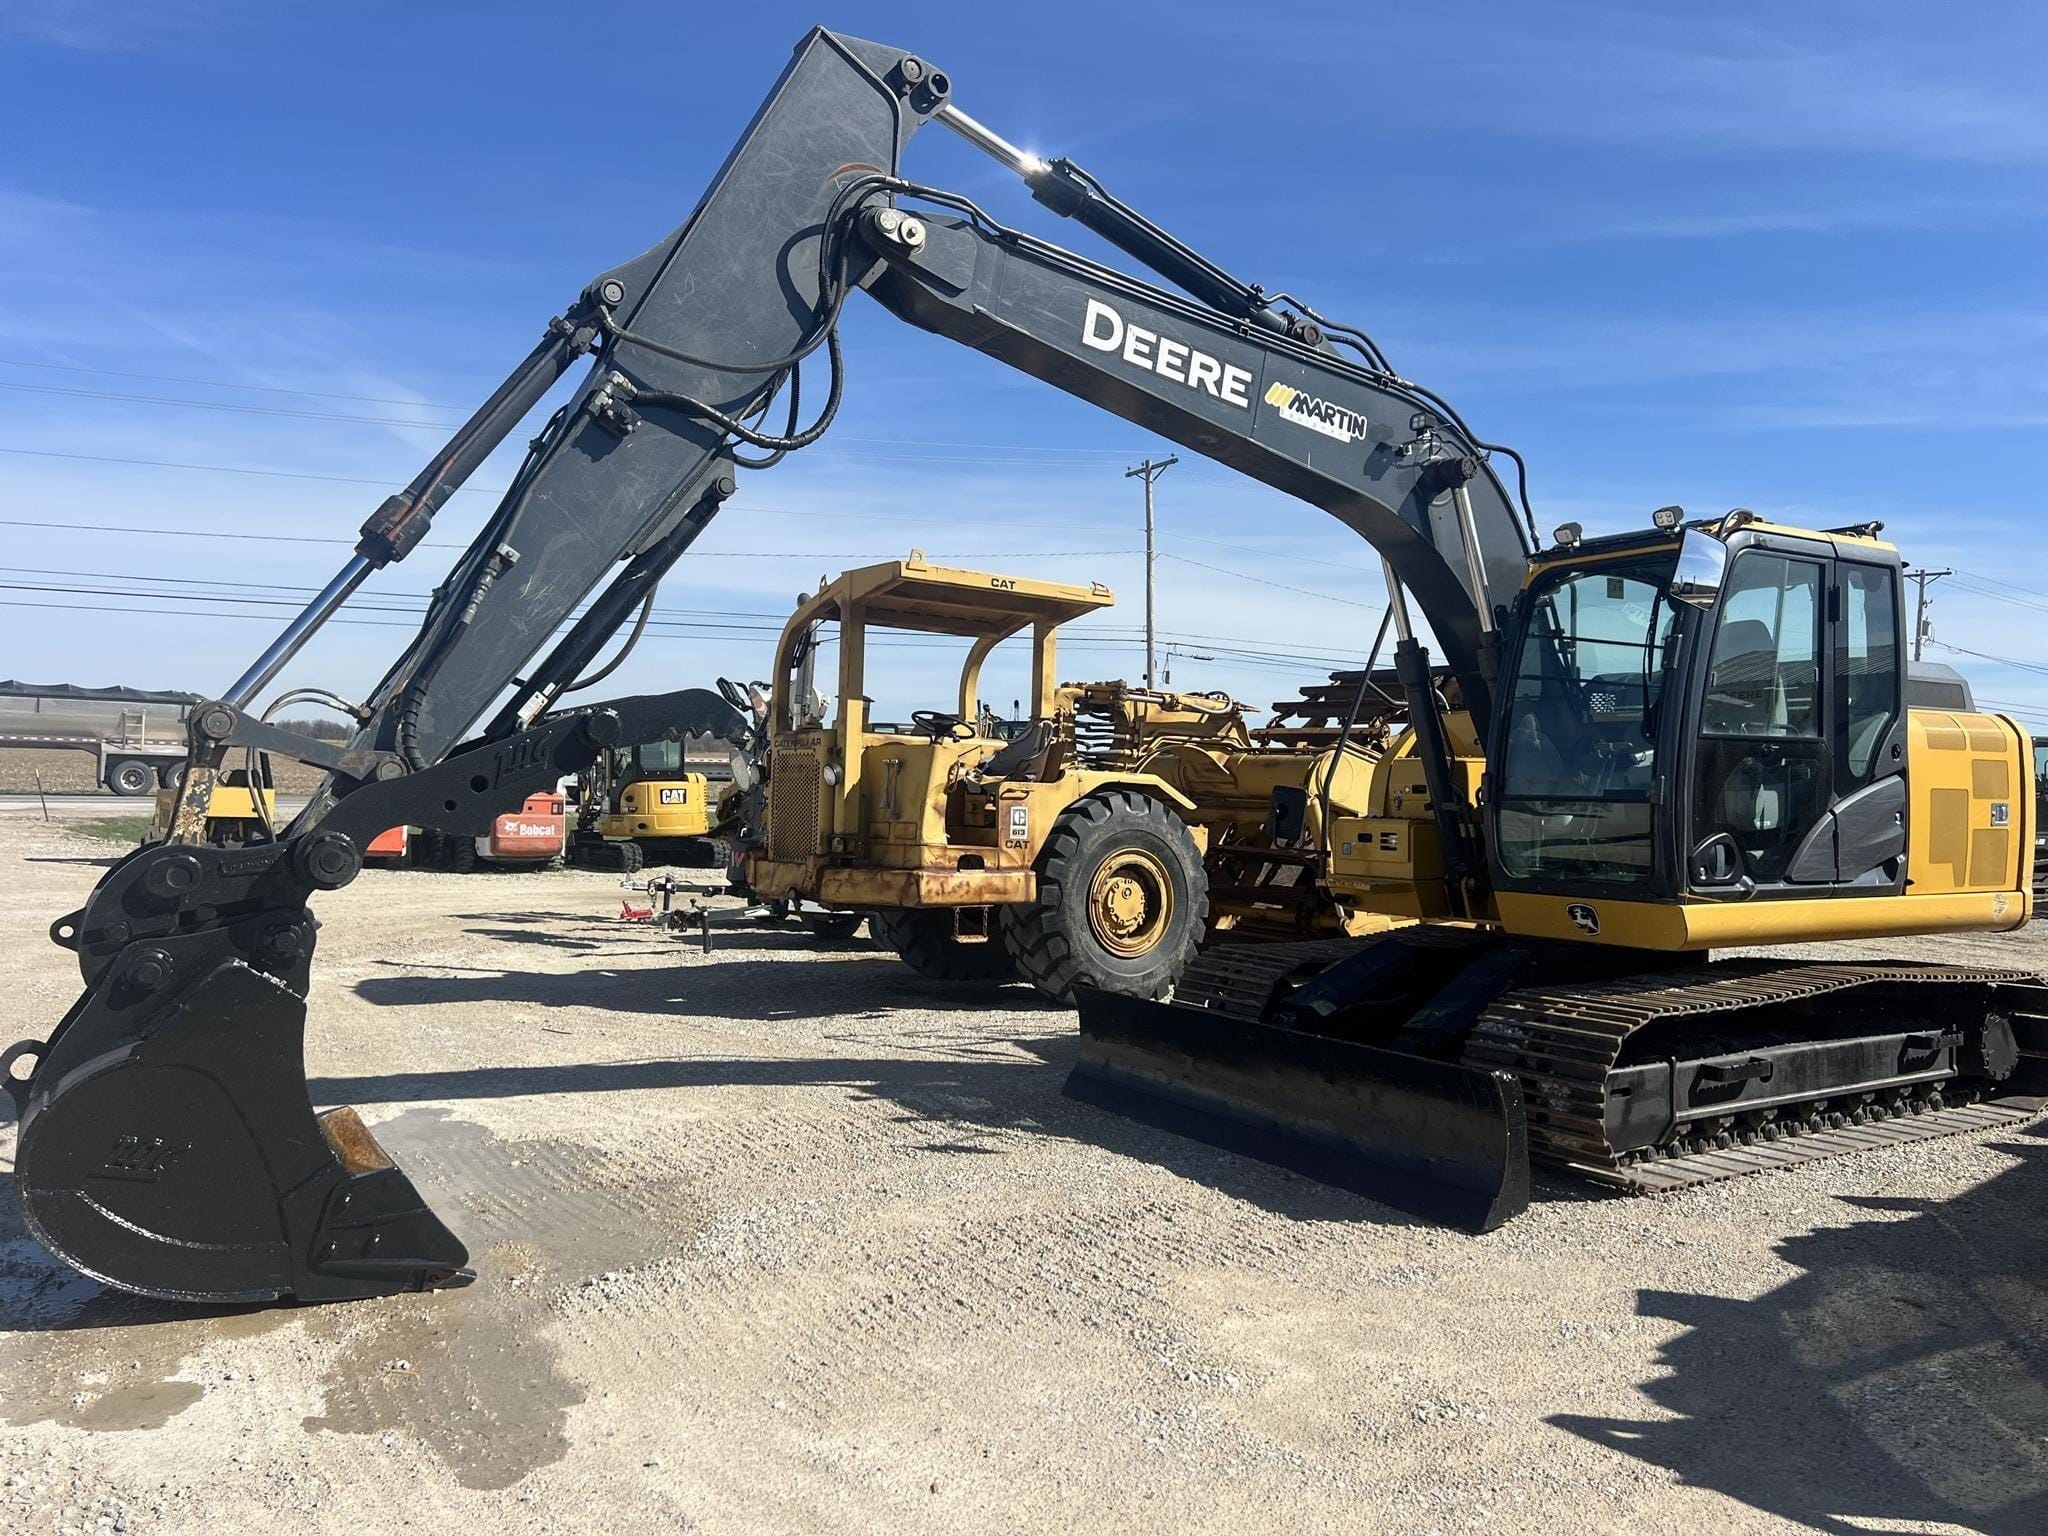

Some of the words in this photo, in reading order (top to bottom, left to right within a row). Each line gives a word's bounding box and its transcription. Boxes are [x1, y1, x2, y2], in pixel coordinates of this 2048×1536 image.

[1082, 298, 1253, 408] DEERE
[1288, 392, 1366, 438] MARTIN
[991, 577, 1017, 590] CAT
[774, 737, 822, 748] CATERPILLAR
[661, 789, 686, 804] CAT
[519, 823, 556, 836] Bobcat
[1005, 840, 1030, 849] CAT
